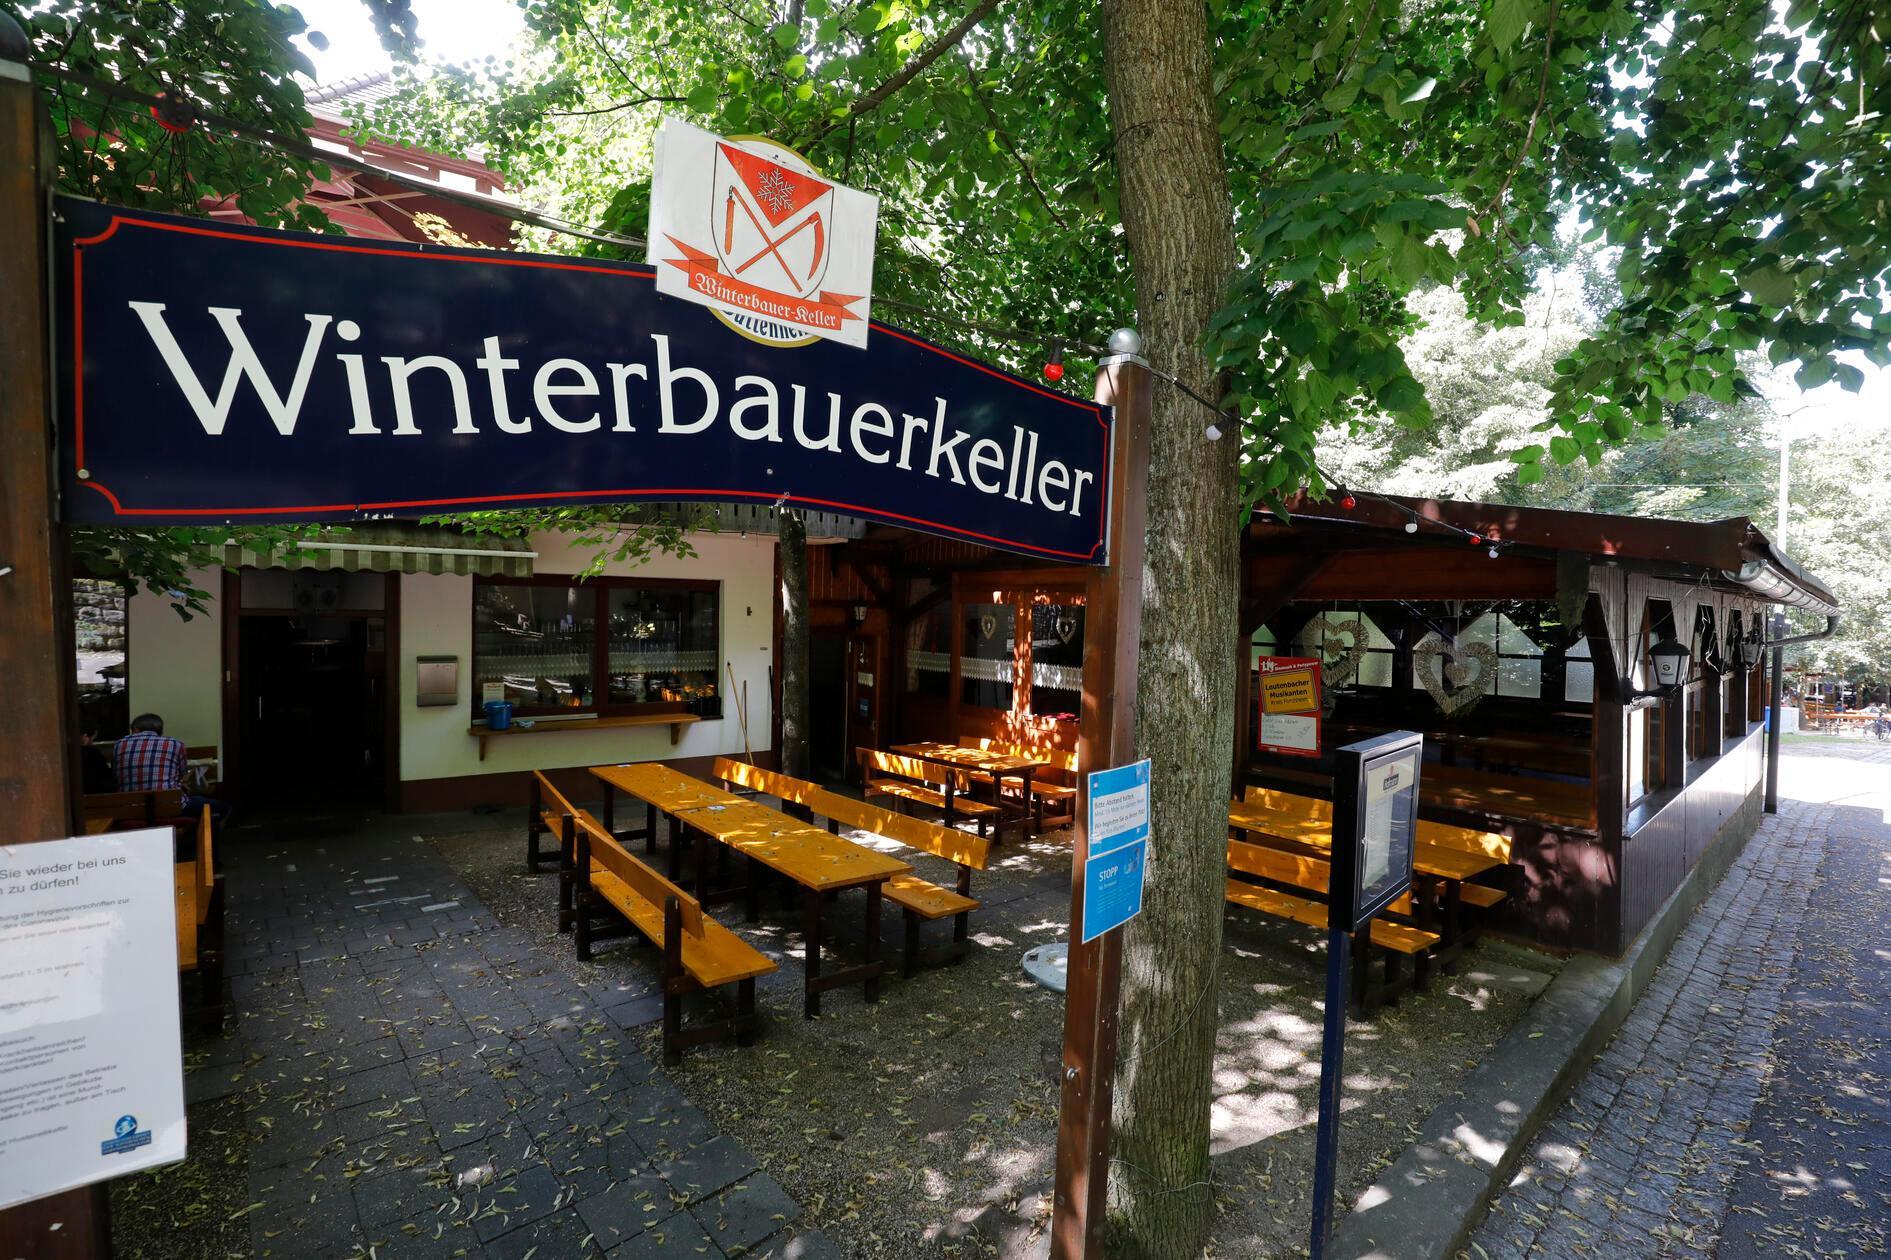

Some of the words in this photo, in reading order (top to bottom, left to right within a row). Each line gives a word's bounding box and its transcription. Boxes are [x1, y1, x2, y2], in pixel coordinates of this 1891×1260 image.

[694, 272, 837, 327] Winterbauer-Keller
[128, 300, 1094, 517] Winterbauerkeller
[1265, 680, 1309, 690] Leutenbacher
[1270, 689, 1308, 698] Musikanten
[0, 869, 22, 880] Sie
[25, 862, 73, 877] wieder
[77, 858, 98, 871] bei
[102, 856, 127, 867] uns
[1099, 865, 1119, 882] STOPP
[8, 885, 25, 895] zu
[30, 875, 79, 892] dürfen!
